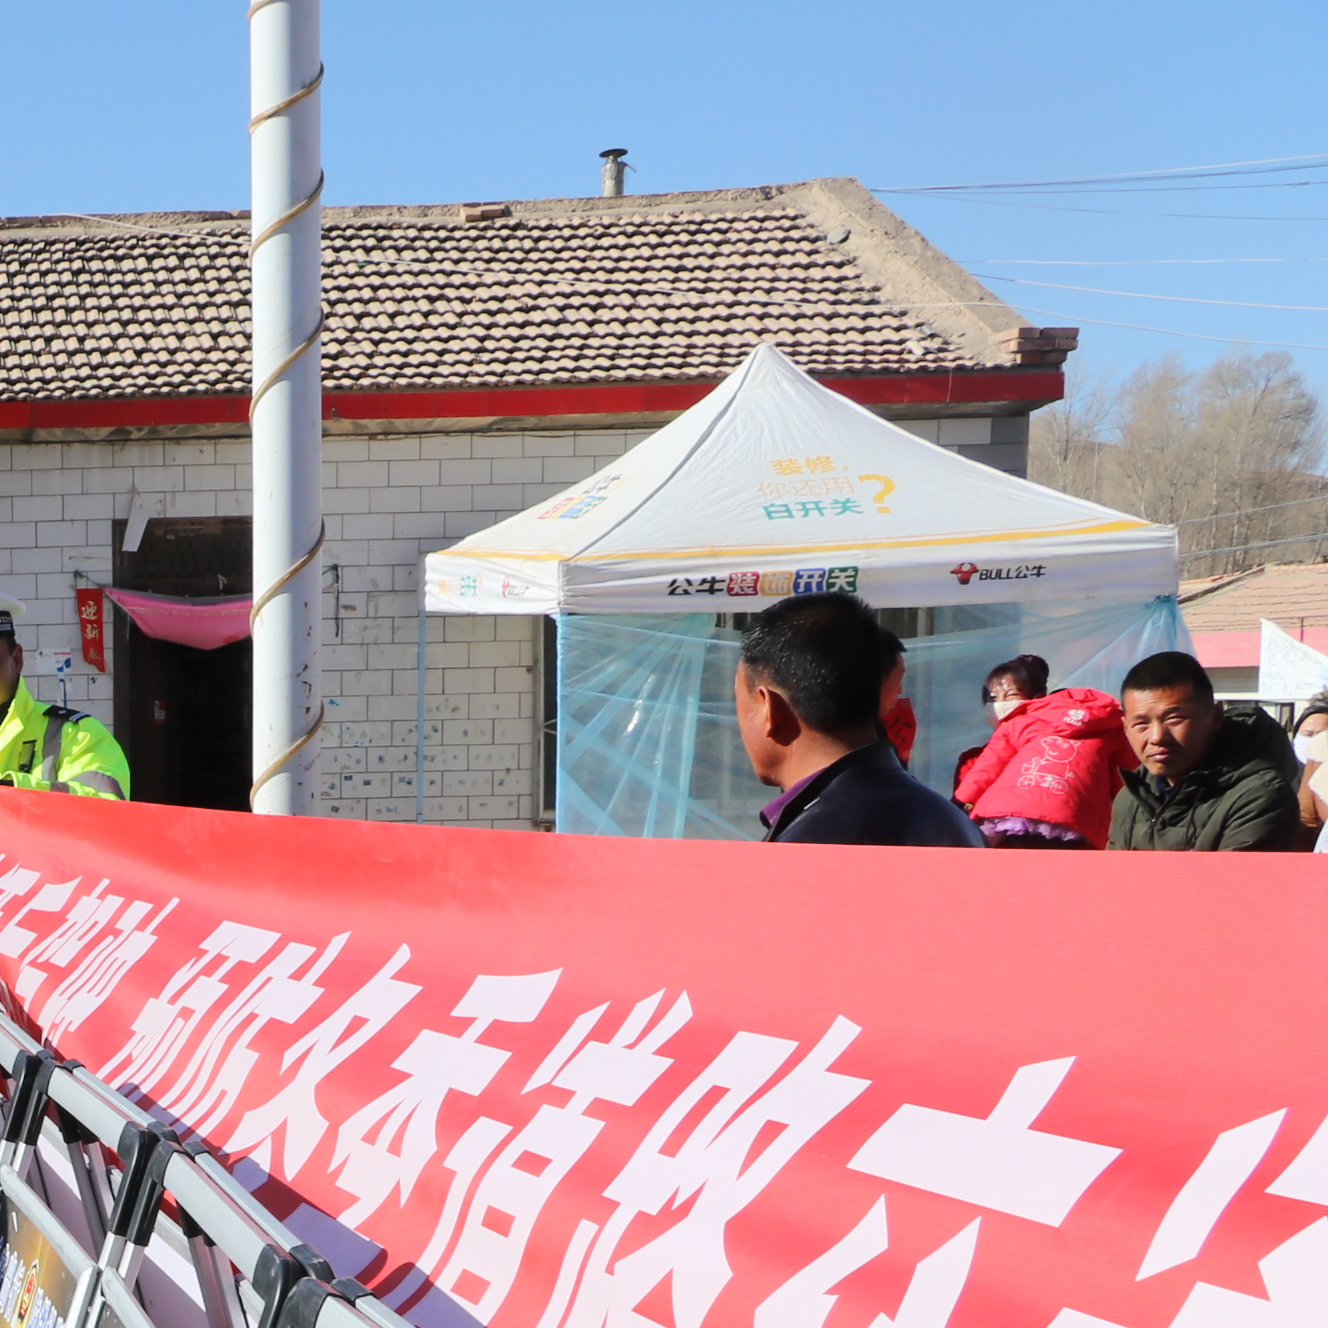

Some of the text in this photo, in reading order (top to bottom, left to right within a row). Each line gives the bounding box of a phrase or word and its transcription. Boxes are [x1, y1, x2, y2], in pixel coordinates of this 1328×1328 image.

[757, 476, 856, 499] 你还用
[762, 498, 865, 521] 白开关
[666, 565, 860, 597] 公牛装饰开关
